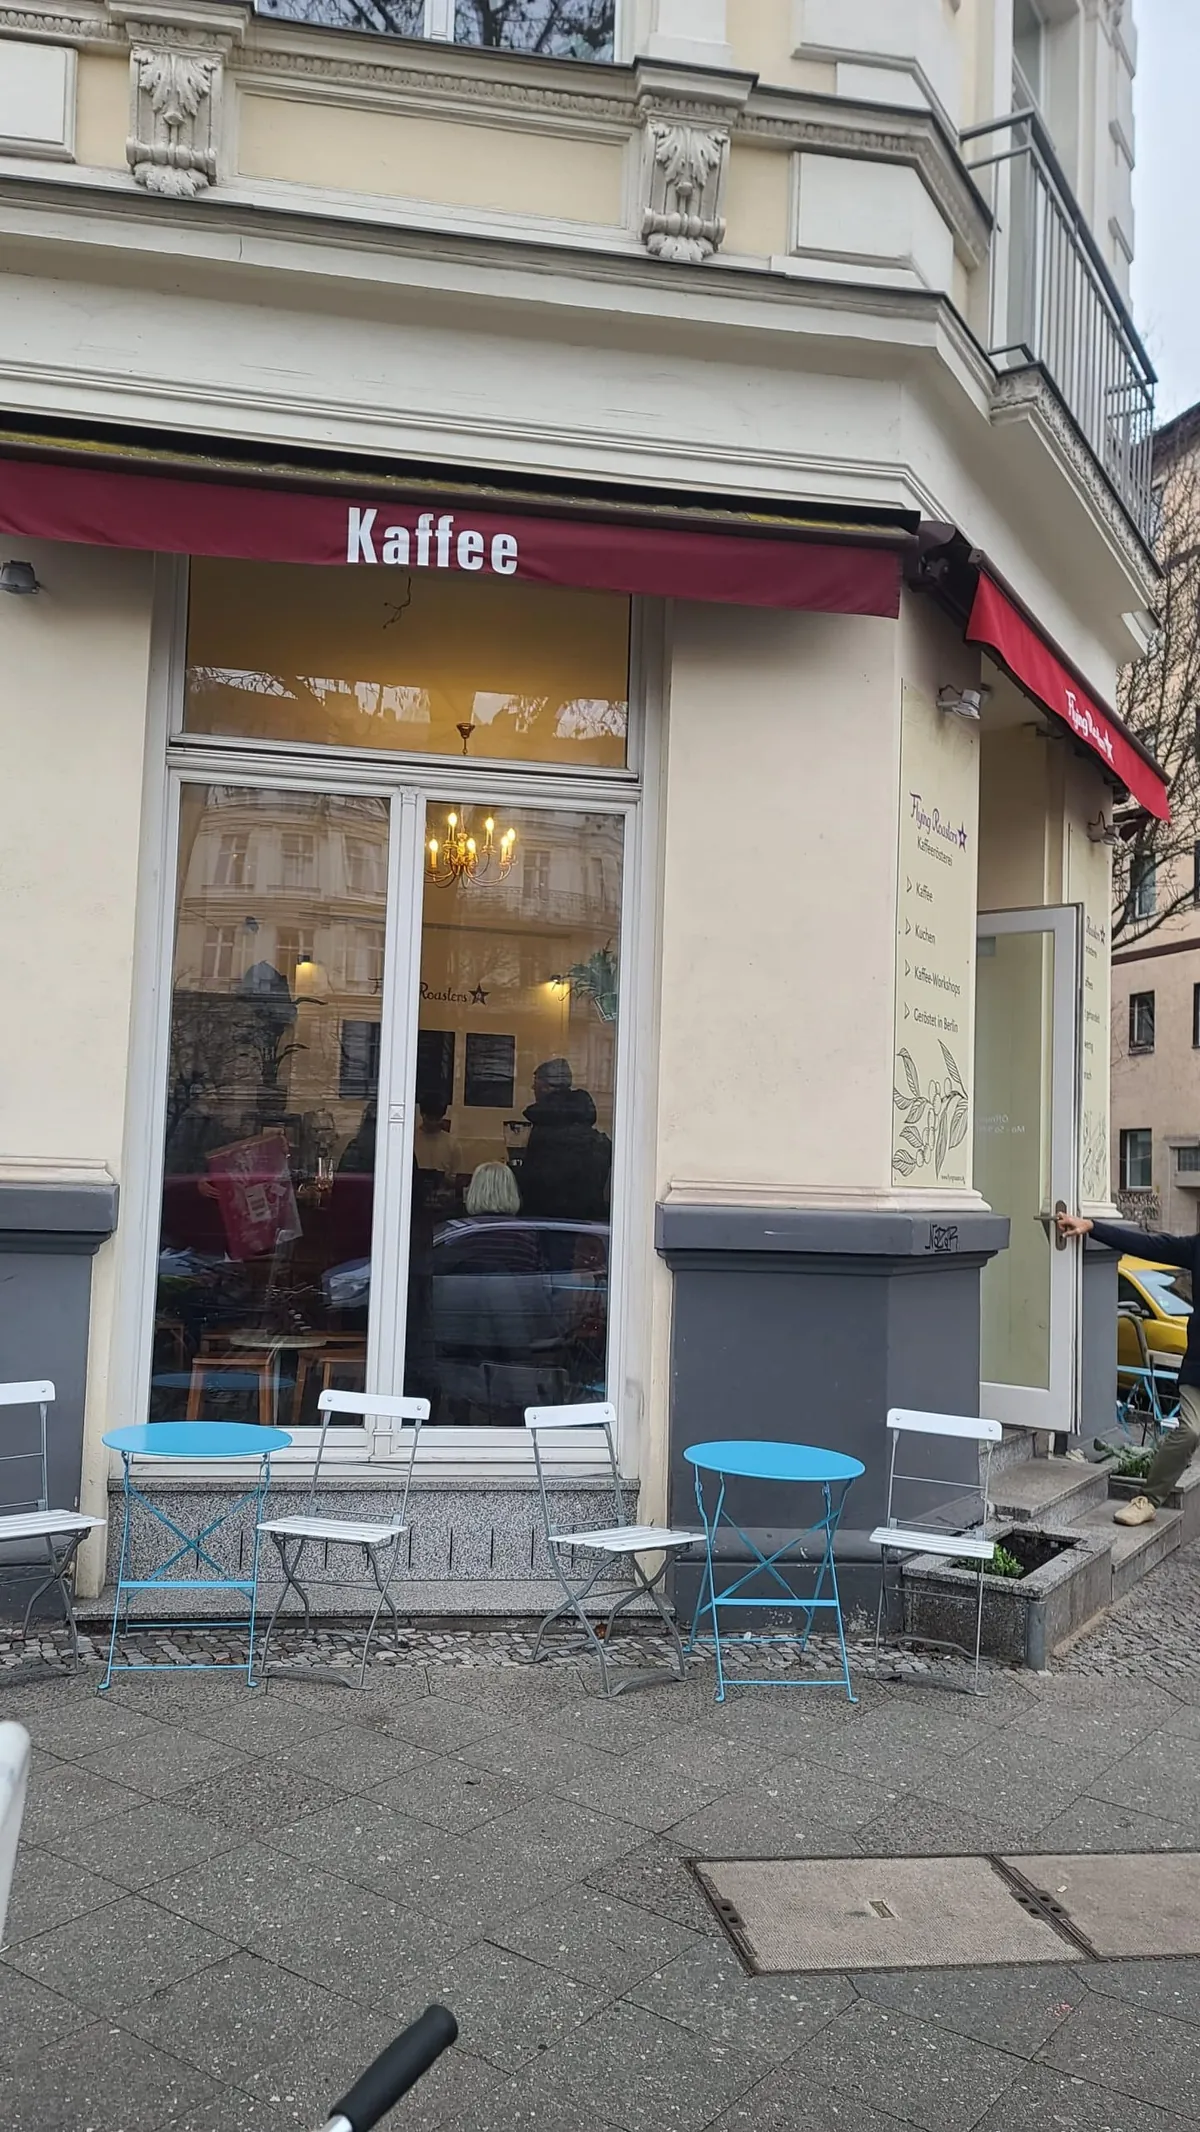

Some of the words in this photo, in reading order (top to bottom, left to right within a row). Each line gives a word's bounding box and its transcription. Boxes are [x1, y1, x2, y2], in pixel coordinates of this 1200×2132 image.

[347, 506, 518, 575] Kaffee
[1065, 688, 1088, 737] Flying
[909, 790, 932, 835] Flying
[932, 808, 958, 845] Roasters
[917, 836, 953, 867] Kaffeerösterei
[915, 882, 934, 903] Kaffee
[915, 923, 936, 945] Kuchen
[419, 982, 468, 1002] Roasters
[913, 1007, 937, 1027] Geröstet
[943, 1017, 959, 1033] Berlin
